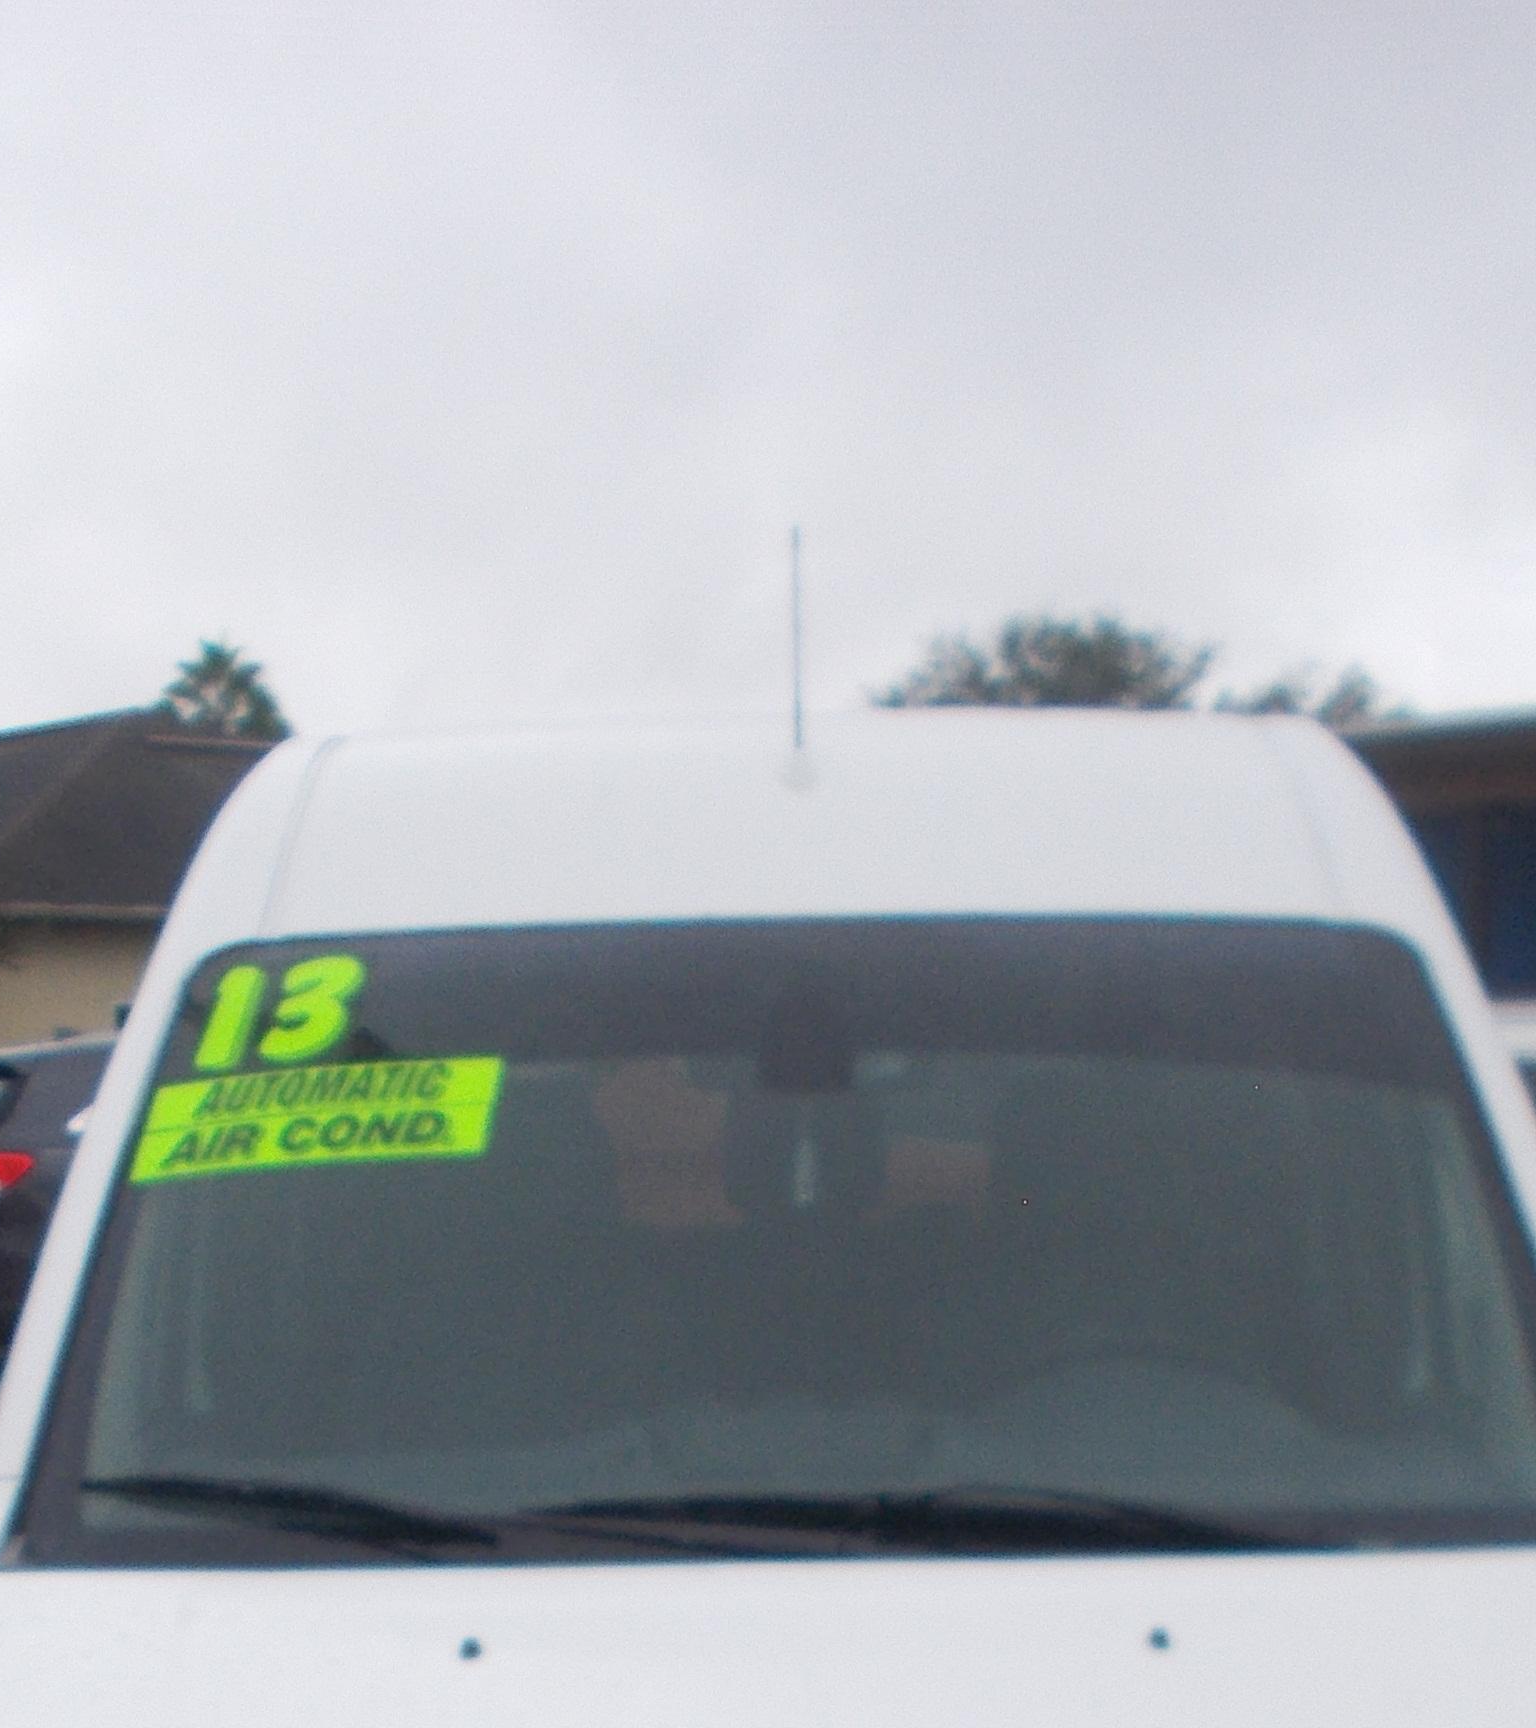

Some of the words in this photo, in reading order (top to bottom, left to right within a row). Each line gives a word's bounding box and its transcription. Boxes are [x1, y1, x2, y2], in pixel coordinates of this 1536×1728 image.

[193, 953, 366, 1073] 13
[192, 1062, 452, 1119] AUTOMATIC
[158, 1123, 261, 1168] AIR
